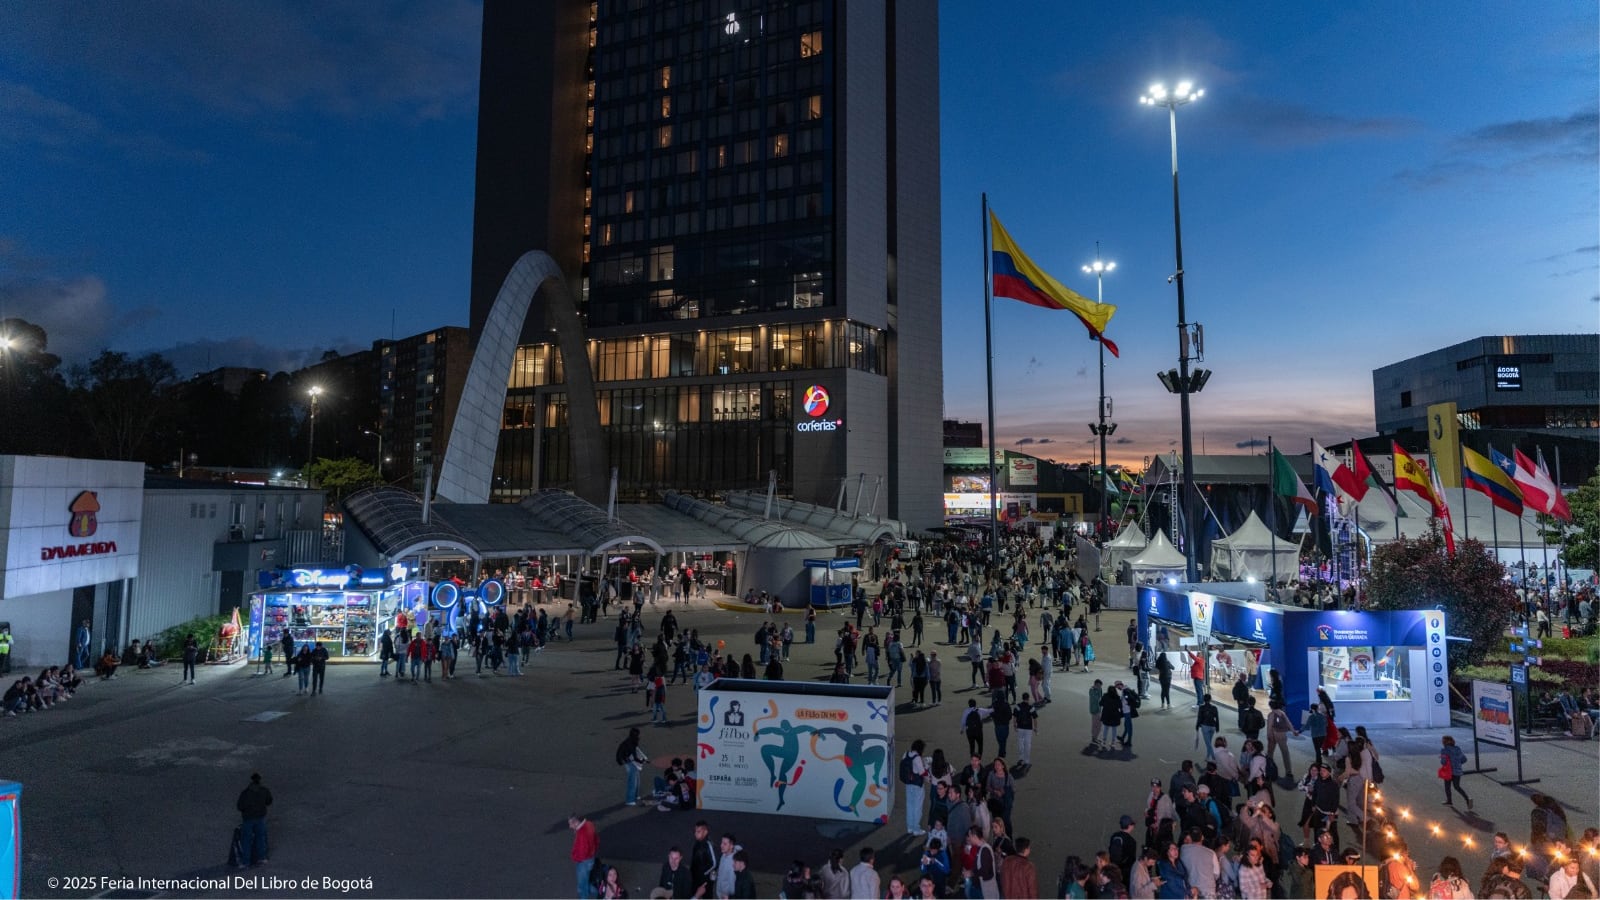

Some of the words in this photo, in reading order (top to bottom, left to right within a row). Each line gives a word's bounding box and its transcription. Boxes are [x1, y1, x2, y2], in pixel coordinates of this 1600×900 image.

[797, 419, 836, 431] corferias
[1433, 413, 1443, 440] 3
[41, 541, 117, 560] DAVIVIENDA
[293, 568, 349, 590] Disney
[718, 727, 750, 740] filbo
[721, 753, 729, 762] 25
[709, 774, 732, 782] ESPAÑA
